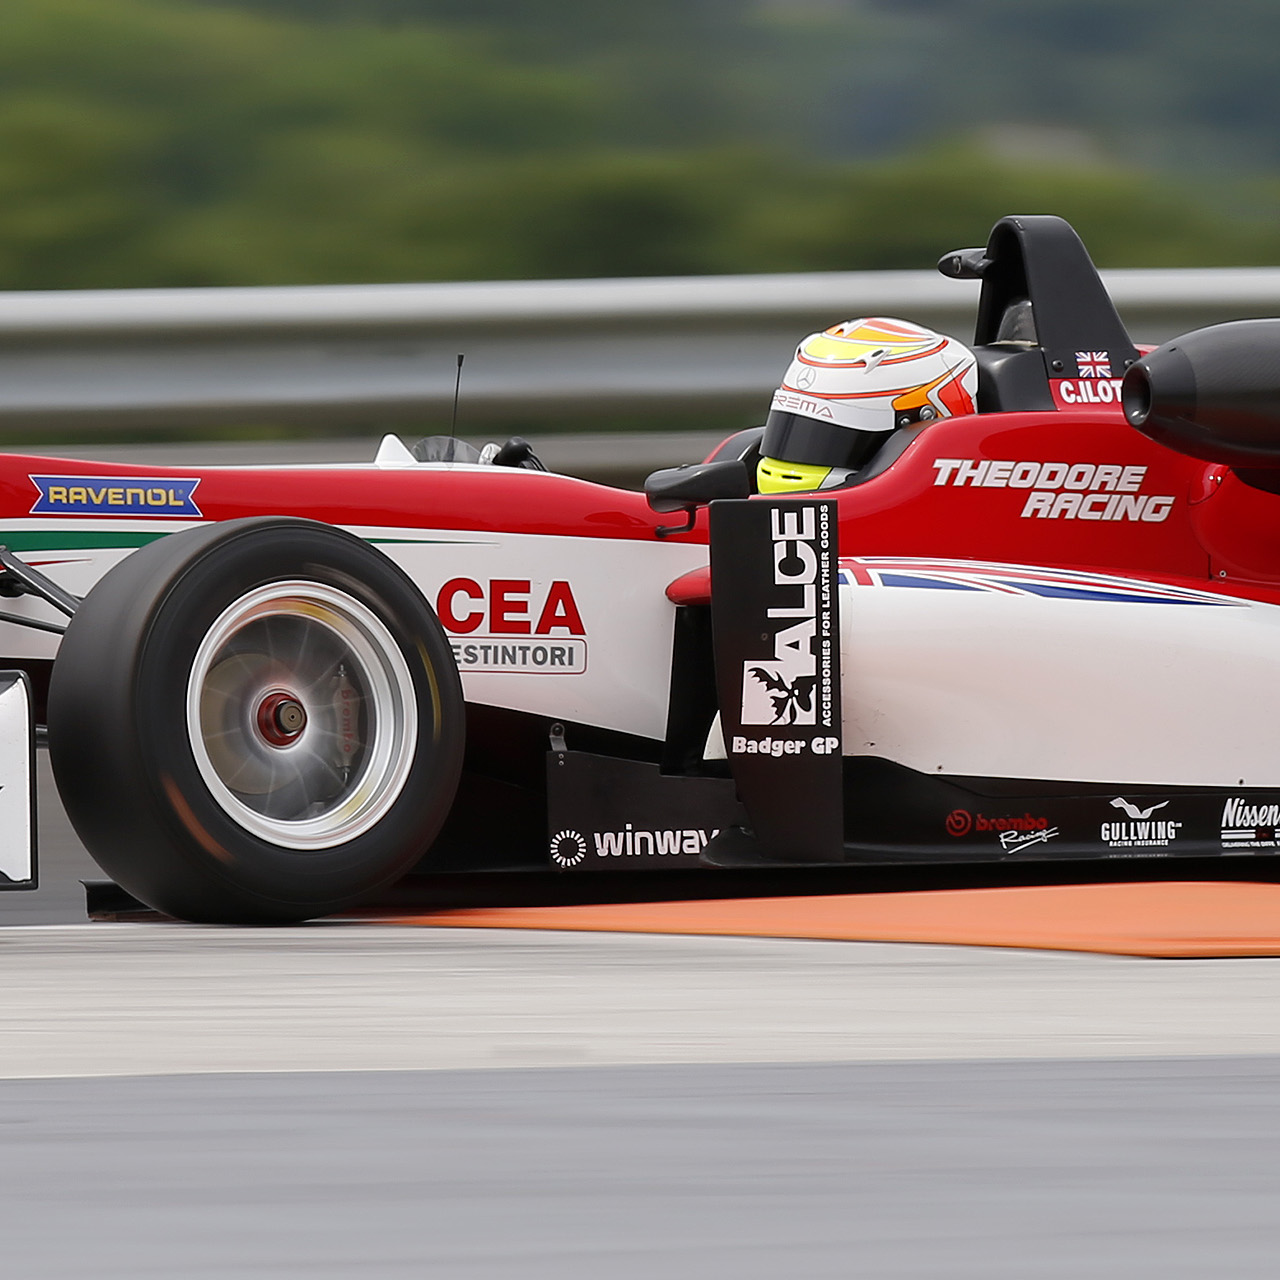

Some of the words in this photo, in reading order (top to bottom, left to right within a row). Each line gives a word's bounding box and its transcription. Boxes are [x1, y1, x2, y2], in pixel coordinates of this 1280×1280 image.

[932, 459, 1148, 491] THEODORE
[48, 486, 176, 507] RAVENOL
[1020, 491, 1176, 522] RACING
[820, 504, 830, 549] GOODS
[821, 551, 831, 608] LEATHER
[436, 577, 587, 636] CEA
[821, 610, 831, 637] FOR
[451, 644, 575, 666] ESTINTORI
[822, 639, 832, 727] ACCESSORIES
[732, 736, 807, 757] Badger
[810, 736, 840, 755] GP
[975, 813, 1049, 831] brembo
[1101, 820, 1177, 841] GULLWING
[999, 826, 1060, 854] Racing
